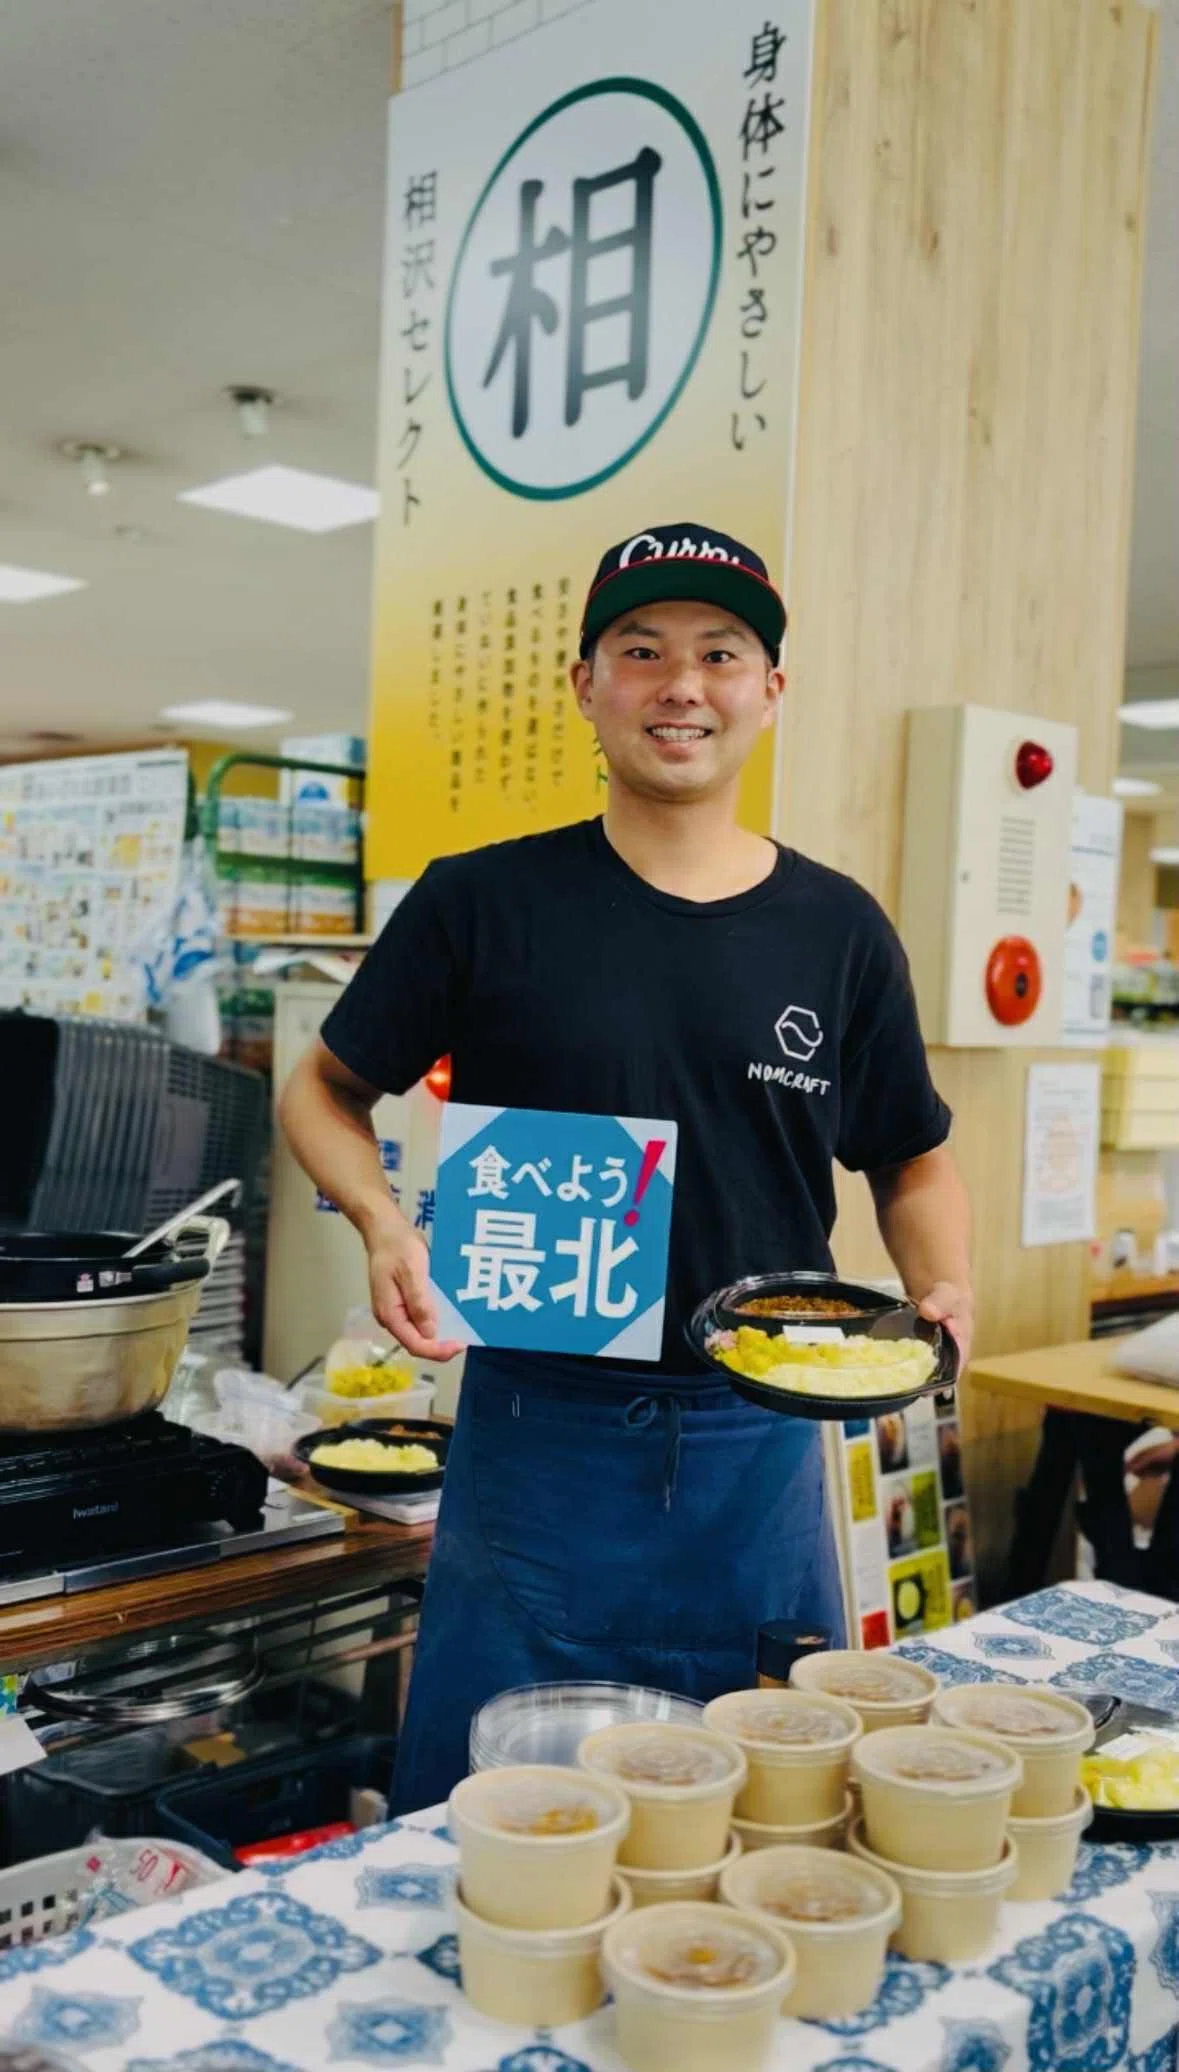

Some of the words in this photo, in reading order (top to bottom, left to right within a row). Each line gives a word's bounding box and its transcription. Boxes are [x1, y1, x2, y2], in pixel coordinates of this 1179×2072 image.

[398, 169, 440, 527] 相沢セレクト
[482, 145, 662, 439] 相
[732, 20, 786, 451] 身体にやさしい
[747, 1062, 831, 1095] NOMCRAFT
[456, 1209, 640, 1318] 最北
